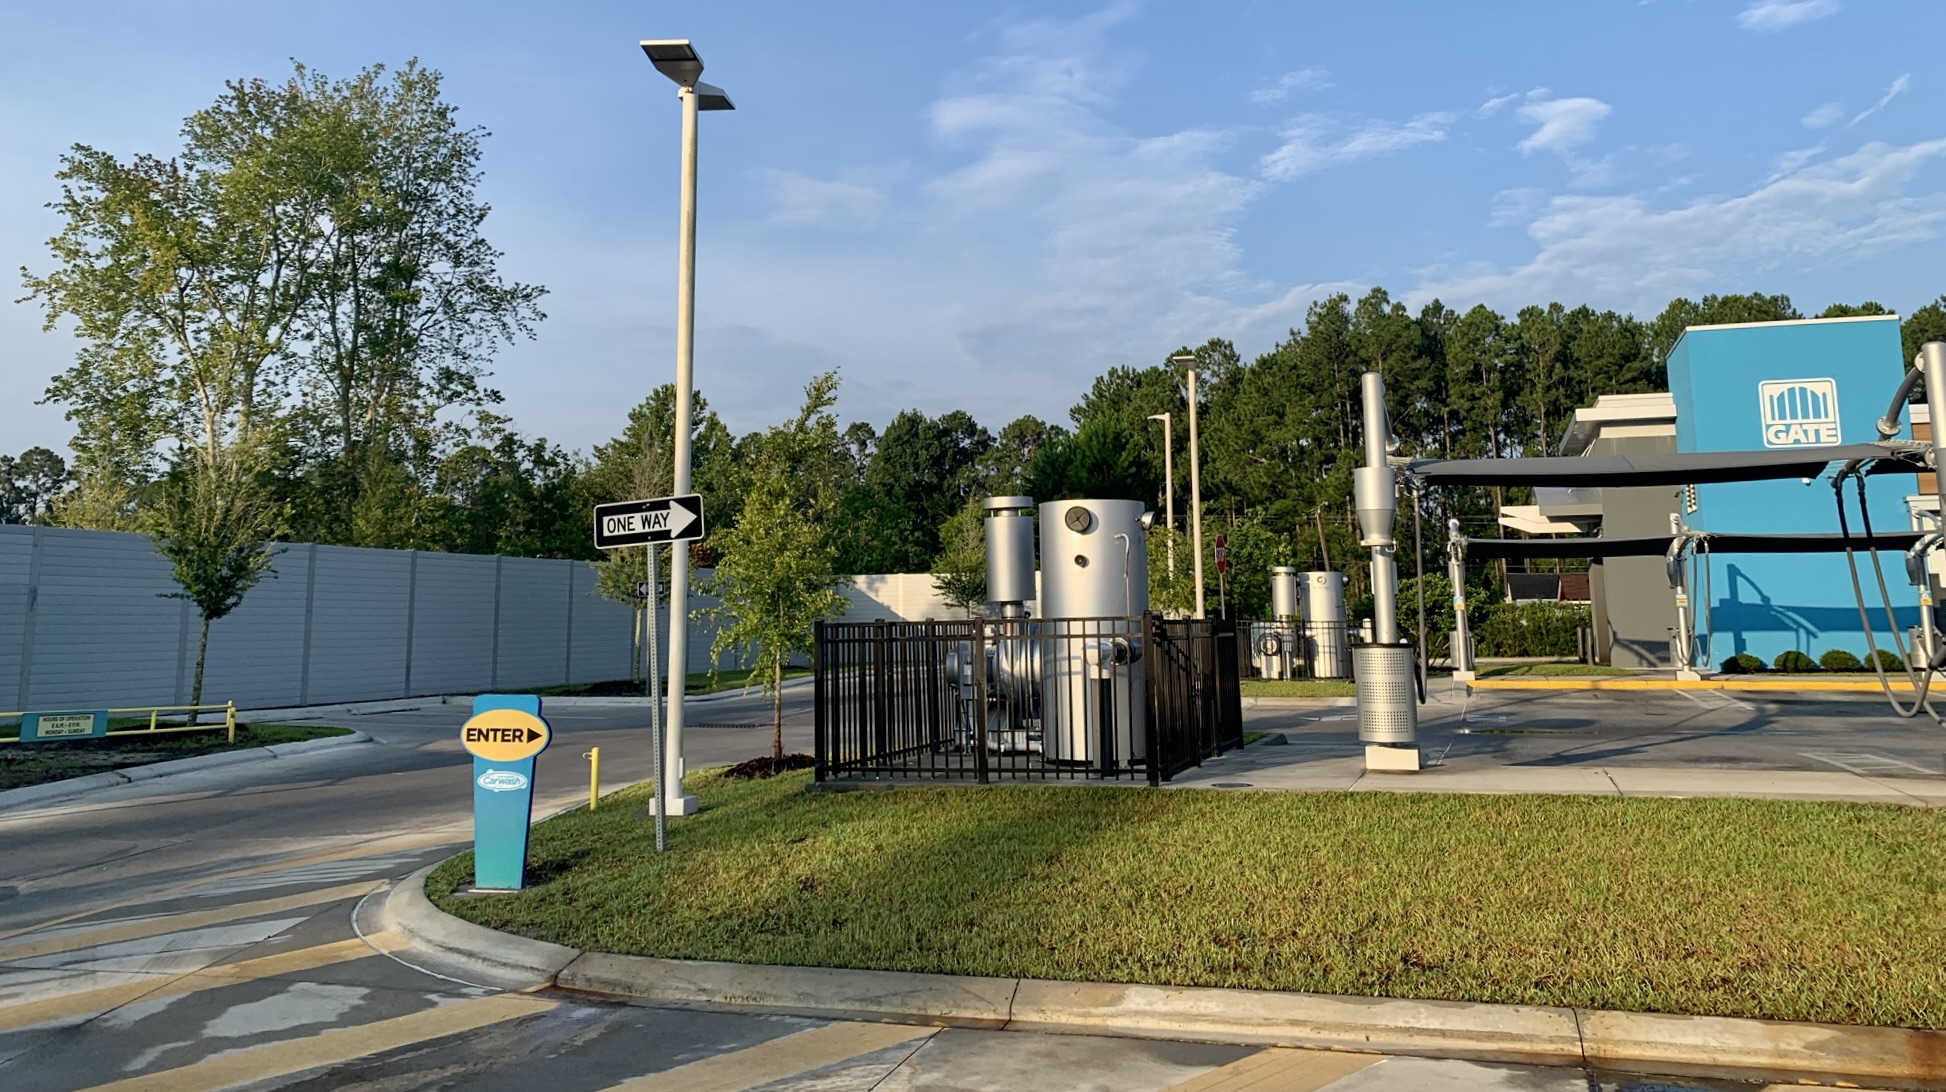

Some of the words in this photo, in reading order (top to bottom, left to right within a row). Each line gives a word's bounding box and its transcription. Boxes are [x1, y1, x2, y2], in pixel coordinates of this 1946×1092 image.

[1767, 423, 1838, 445] GATE
[607, 516, 635, 533] ONE
[641, 511, 670, 530] WAY
[466, 728, 524, 742] ENTER
[483, 776, 521, 785] Carwash
